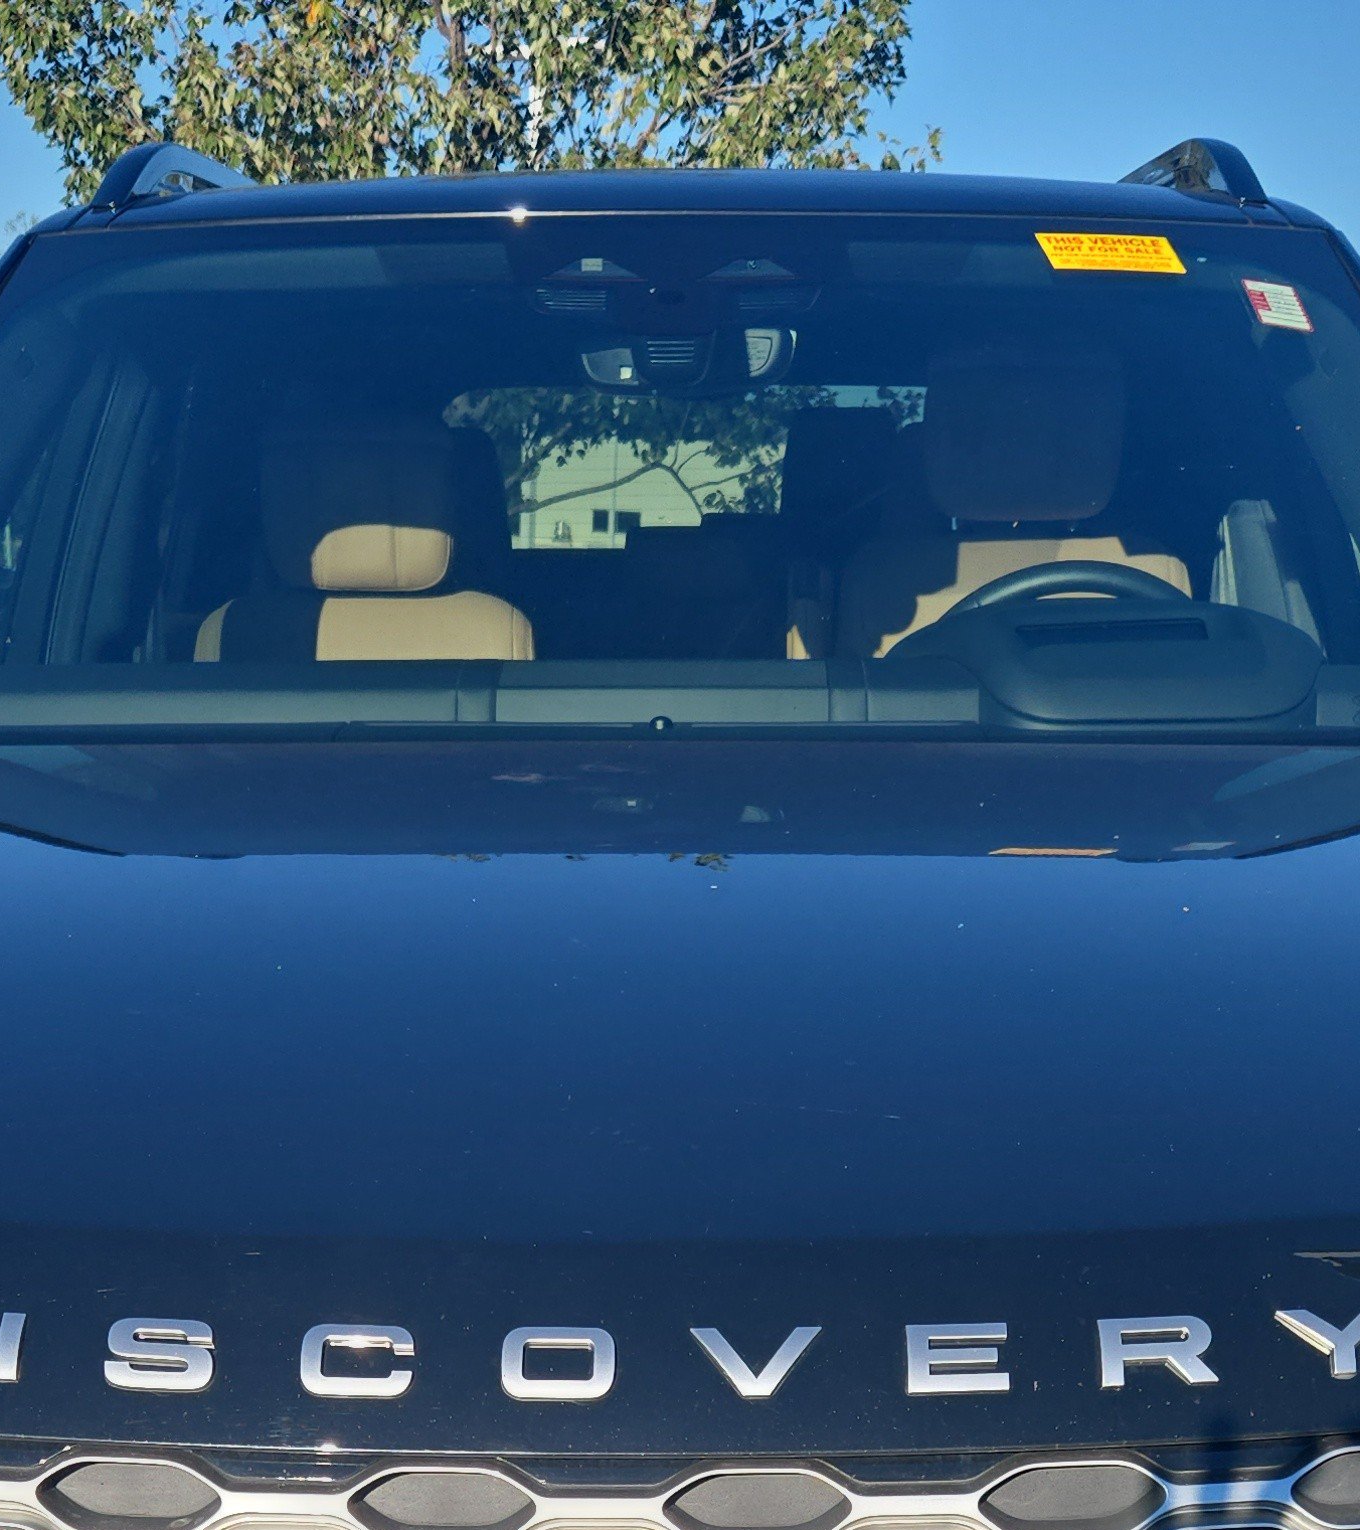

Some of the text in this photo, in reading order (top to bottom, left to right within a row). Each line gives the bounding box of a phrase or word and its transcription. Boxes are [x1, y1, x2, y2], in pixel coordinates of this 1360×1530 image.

[1044, 236, 1161, 247] THIS VEHICLE
[1089, 246, 1119, 254] FOR
[1125, 247, 1162, 255] SALE
